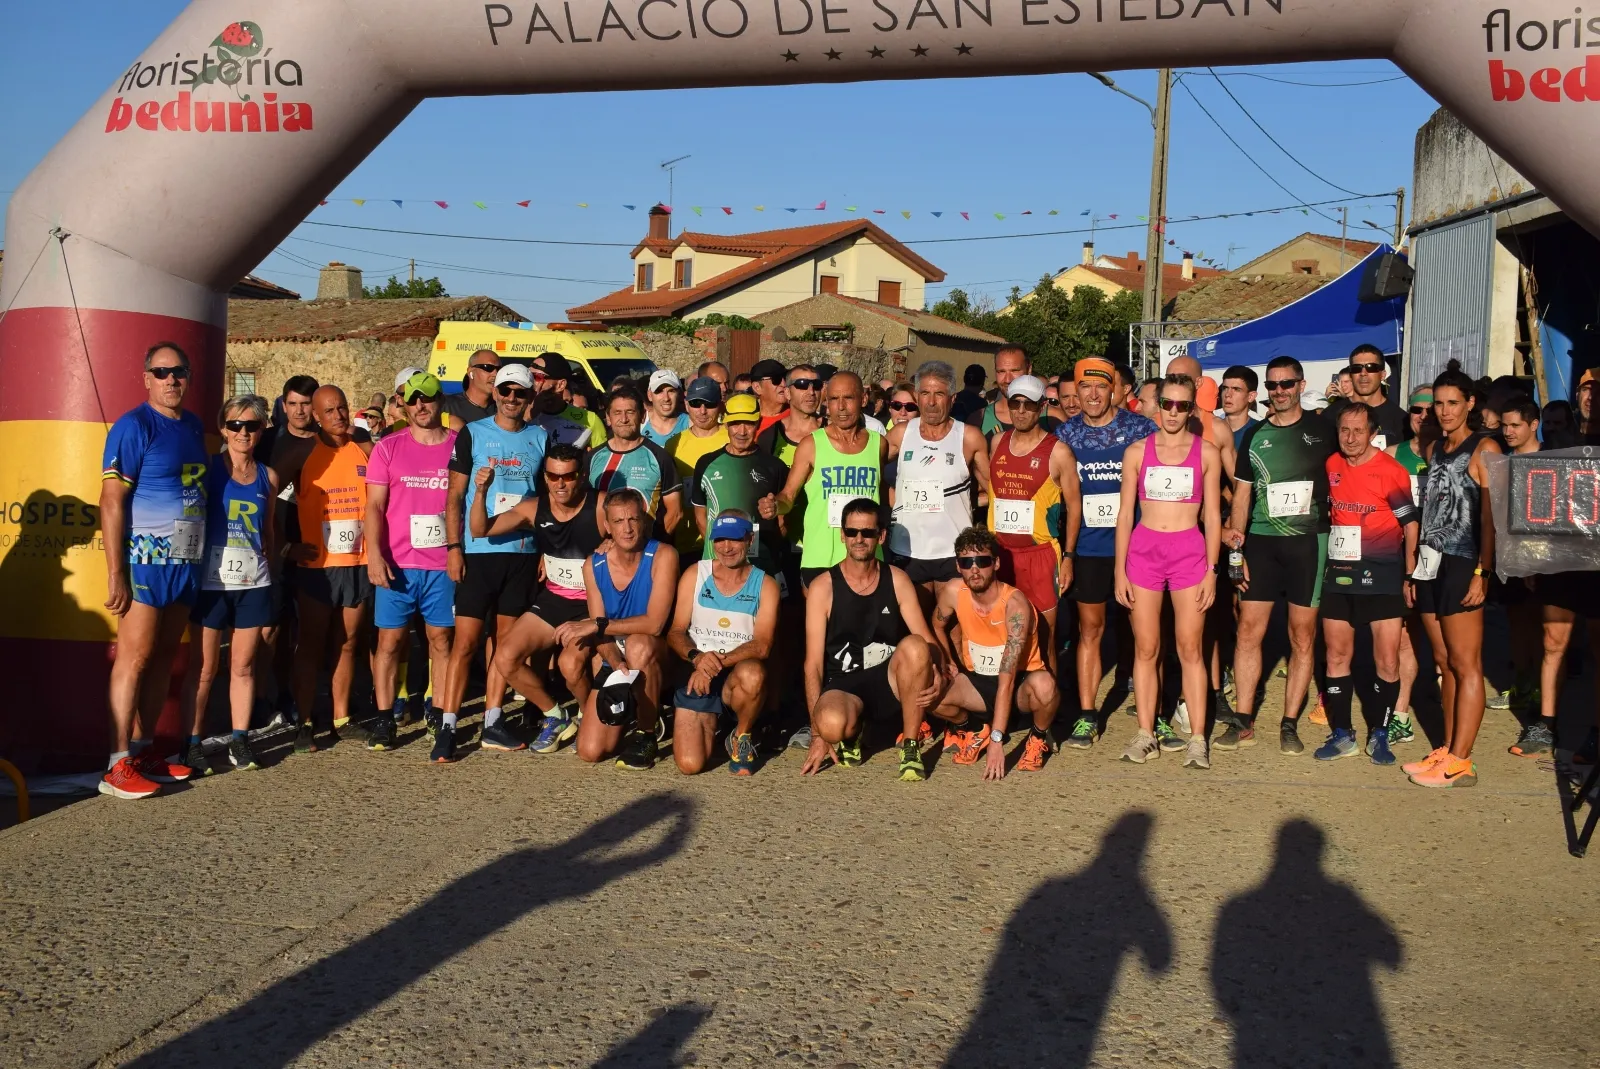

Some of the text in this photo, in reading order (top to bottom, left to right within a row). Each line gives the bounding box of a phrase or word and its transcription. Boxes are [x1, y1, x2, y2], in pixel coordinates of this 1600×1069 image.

[484, 0, 749, 46] PALACIO
[772, 0, 851, 36] DE
[871, 0, 993, 32] SAN
[1481, 6, 1600, 53] floris
[117, 47, 303, 93] floristería
[105, 91, 313, 134] bedunia
[456, 343, 549, 353] AMBULANCIA ASISTENCIAL
[1084, 459, 1123, 474] apache
[400, 475, 430, 484] FEMINIST
[820, 465, 877, 489] START
[1164, 477, 1172, 490] 2
[997, 487, 1029, 496] DE TORO
[1004, 481, 1023, 489] VINO
[913, 490, 928, 502] 73
[1282, 492, 1299, 505] 71
[0, 501, 97, 527] HOSPES
[227, 499, 258, 533] R
[1003, 510, 1019, 523] 10
[1097, 504, 1114, 517] 82
[339, 530, 355, 542] 80
[425, 525, 441, 537] 75
[14, 535, 31, 548] DE
[34, 535, 66, 549] SAN
[187, 534, 199, 547] 13
[1334, 537, 1345, 549] 47
[227, 559, 243, 573] 12
[558, 568, 573, 580] 25
[979, 655, 996, 667] 72
